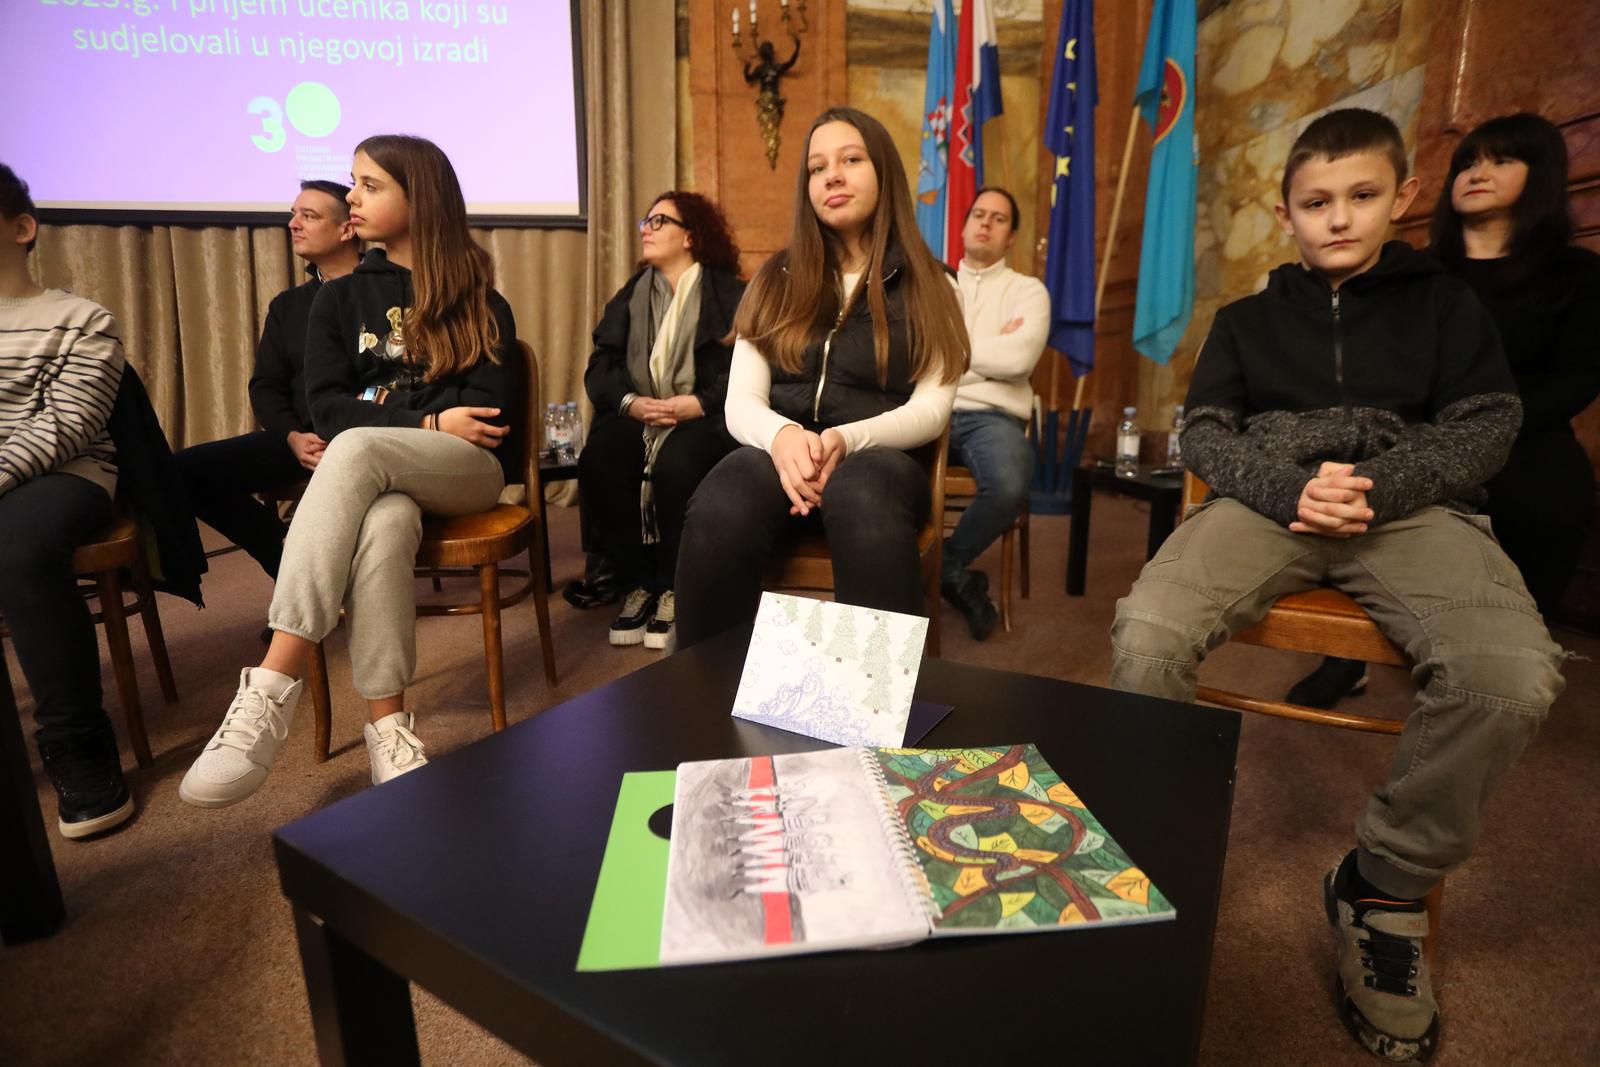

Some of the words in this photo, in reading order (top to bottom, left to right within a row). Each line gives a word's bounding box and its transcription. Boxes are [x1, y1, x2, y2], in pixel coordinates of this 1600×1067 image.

[419, 0, 468, 29] koji
[476, 3, 509, 25] su
[72, 22, 241, 58] sudjelovali
[251, 36, 269, 57] u
[279, 32, 404, 66] njegovoj
[412, 35, 489, 64] izradi
